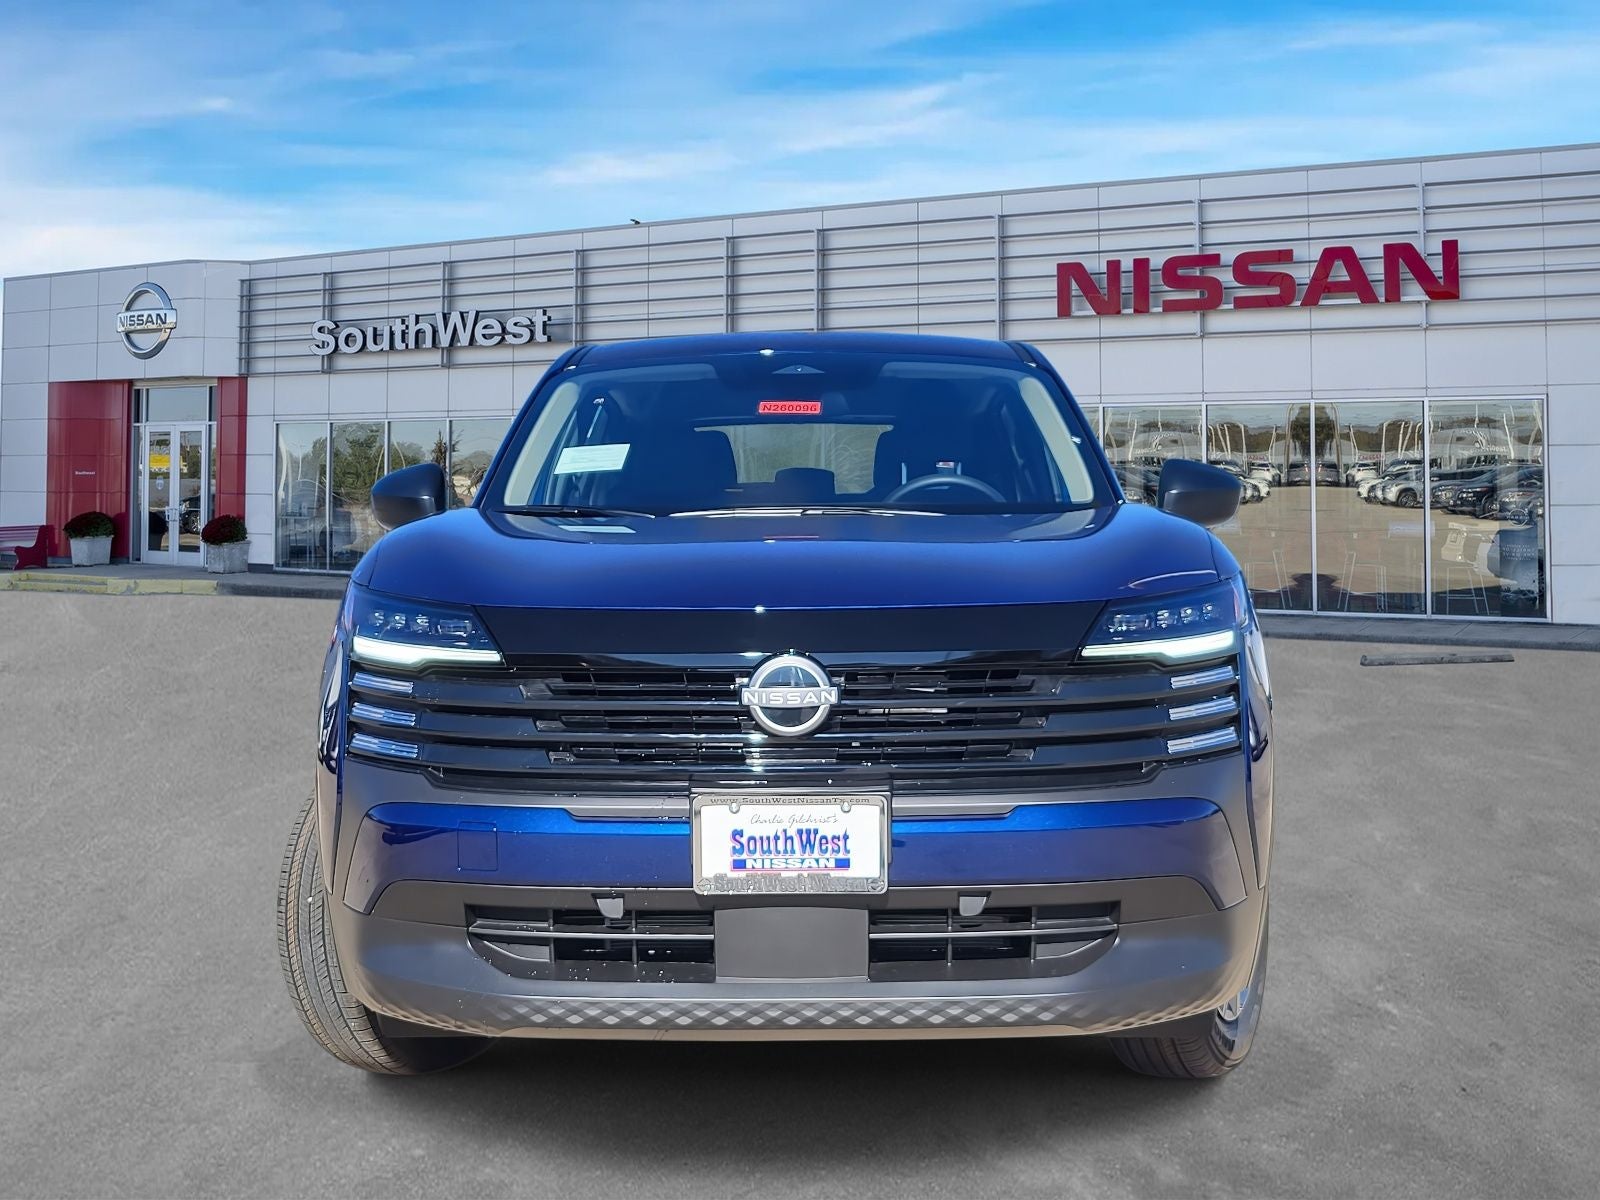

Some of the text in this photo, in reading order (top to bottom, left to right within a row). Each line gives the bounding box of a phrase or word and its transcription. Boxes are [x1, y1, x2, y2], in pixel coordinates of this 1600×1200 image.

[1056, 239, 1460, 318] NISSAN
[118, 312, 168, 328] NISSAN
[309, 308, 551, 356] SouthWest
[743, 690, 838, 705] NISSAN
[730, 827, 851, 857] SouthWest
[745, 858, 836, 869] NISSAN
